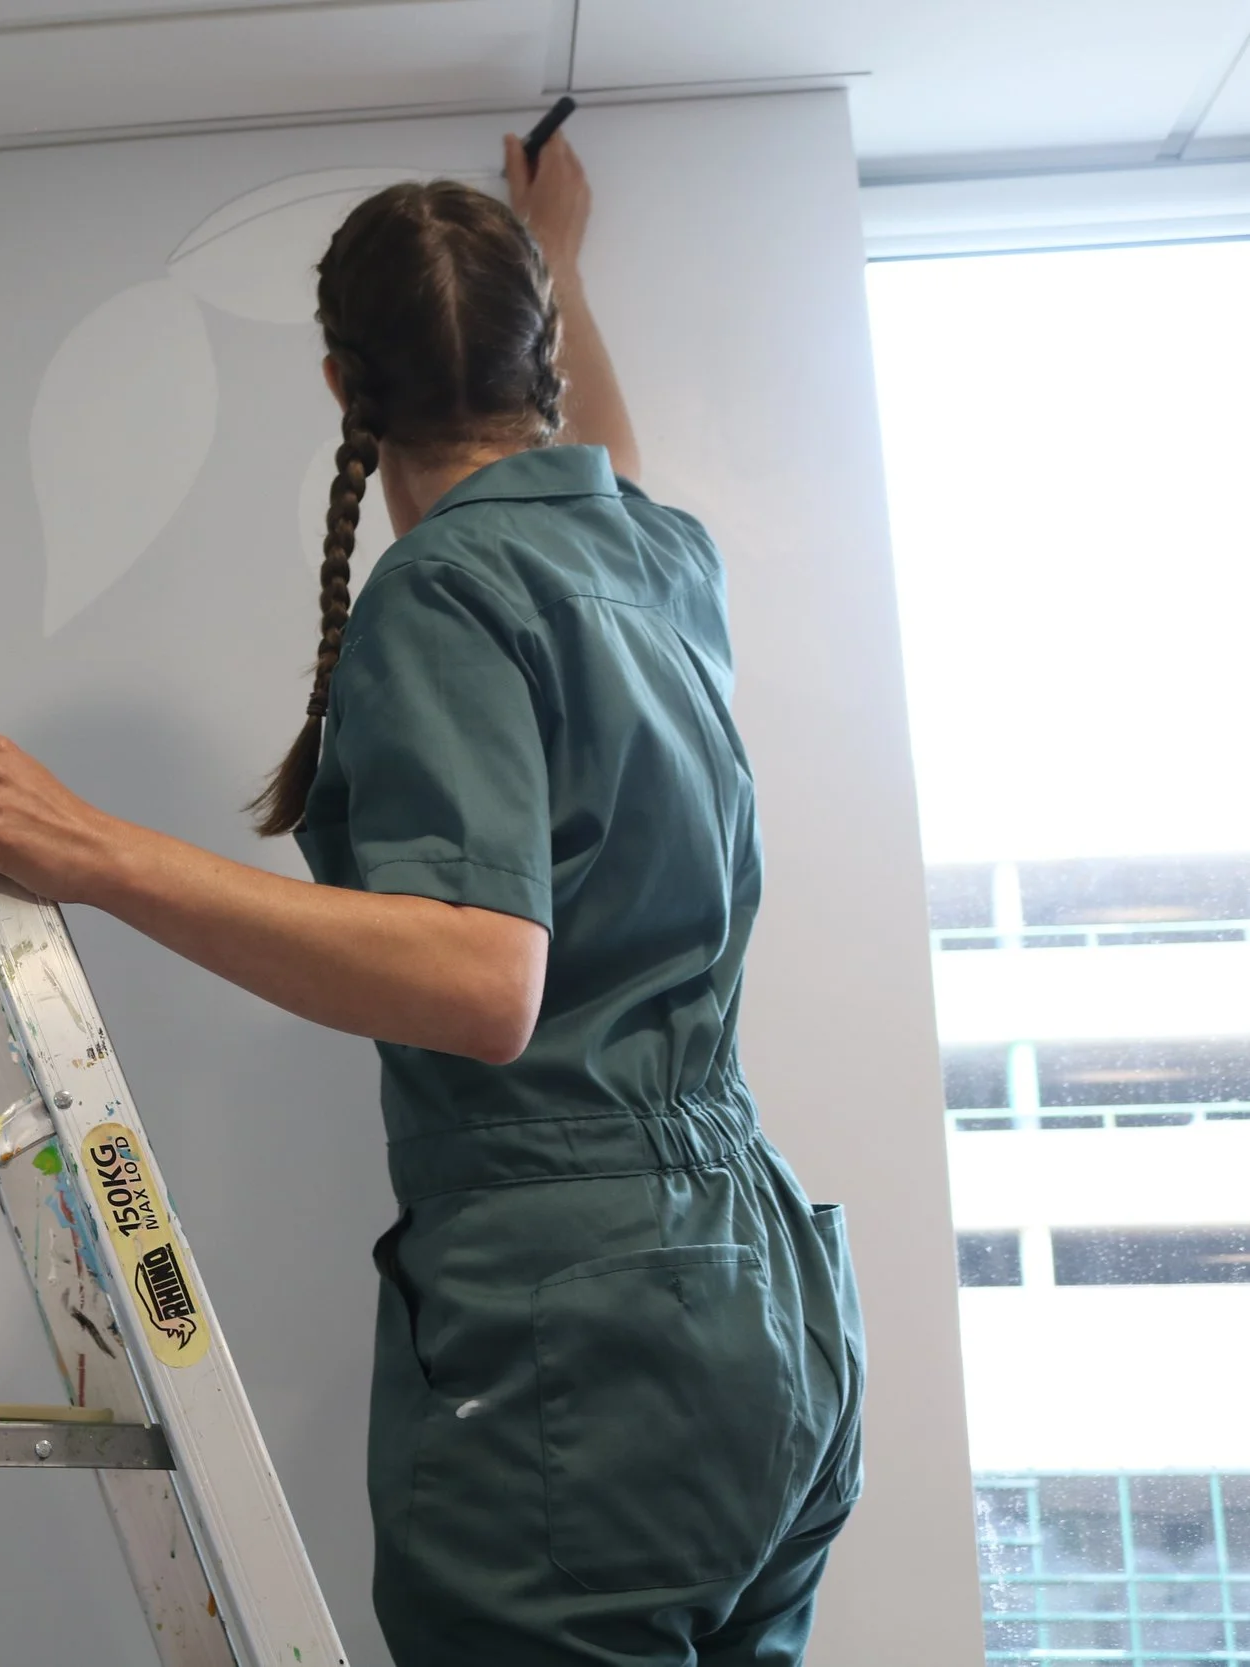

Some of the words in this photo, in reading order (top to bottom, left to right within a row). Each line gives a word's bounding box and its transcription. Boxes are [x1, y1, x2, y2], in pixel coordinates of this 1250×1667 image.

[90, 1143, 143, 1237] 150KG
[114, 1135, 143, 1184] LOD
[132, 1188, 160, 1231] MAX
[142, 1246, 190, 1320] RHINO
